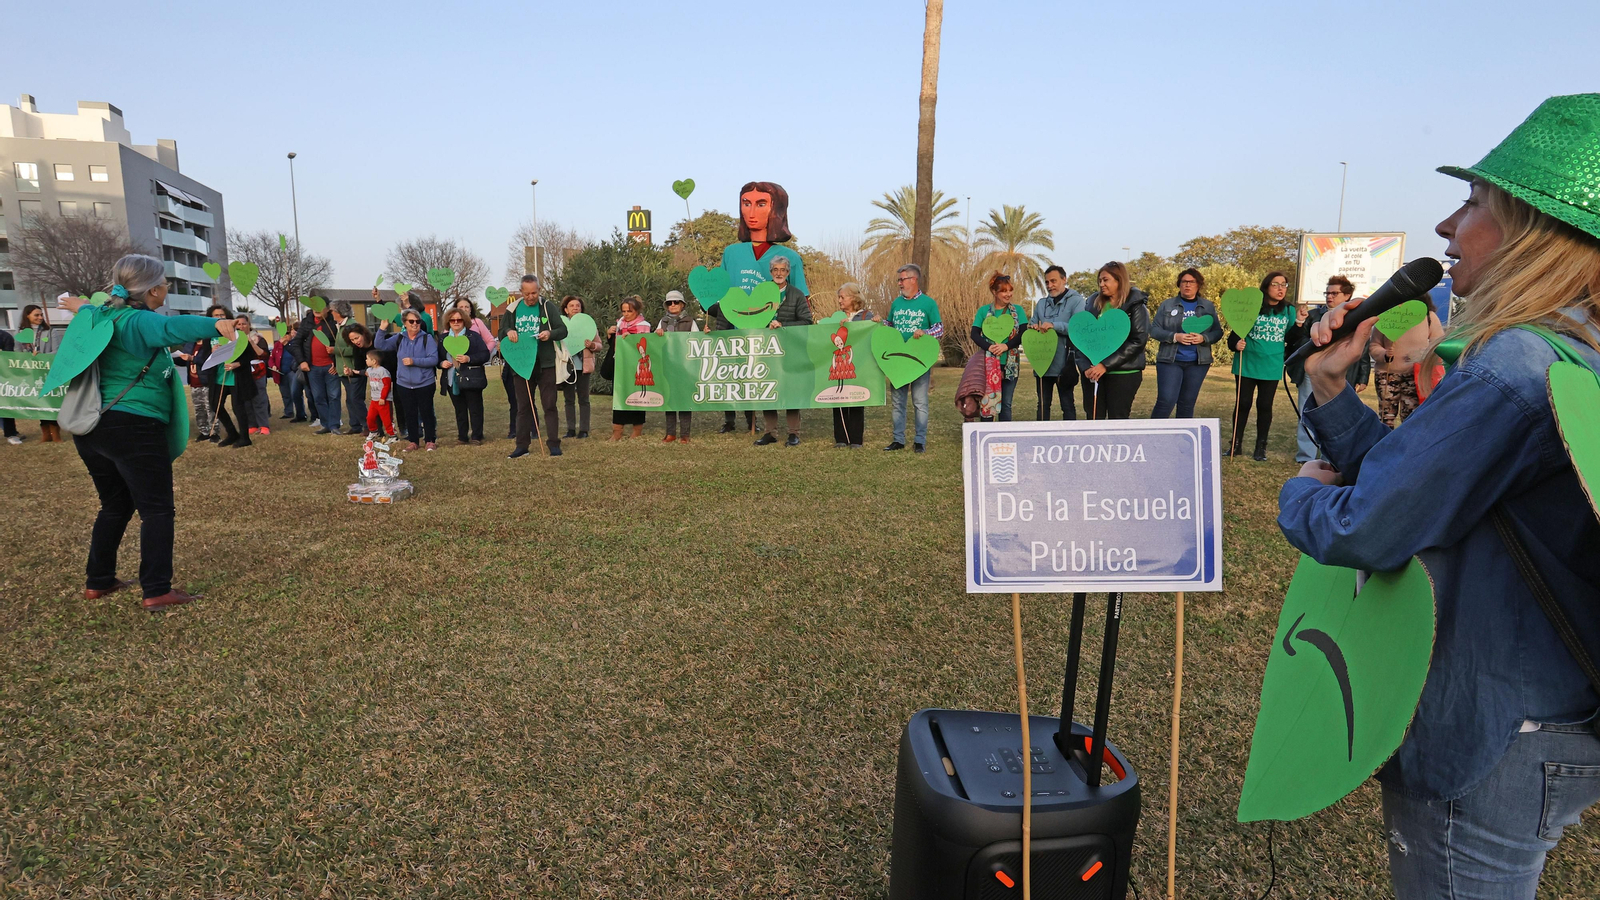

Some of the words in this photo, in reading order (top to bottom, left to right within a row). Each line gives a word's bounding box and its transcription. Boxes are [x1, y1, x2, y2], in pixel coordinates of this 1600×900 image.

[688, 336, 783, 358] MAREA
[8, 359, 50, 369] MAREA
[700, 355, 768, 381] Verde
[693, 381, 777, 402] JEREZ
[1031, 444, 1147, 464] ROTONDA
[997, 492, 1034, 522] De
[1047, 491, 1069, 521] la
[1083, 490, 1192, 521] Escuela
[1031, 540, 1138, 573] Pública
